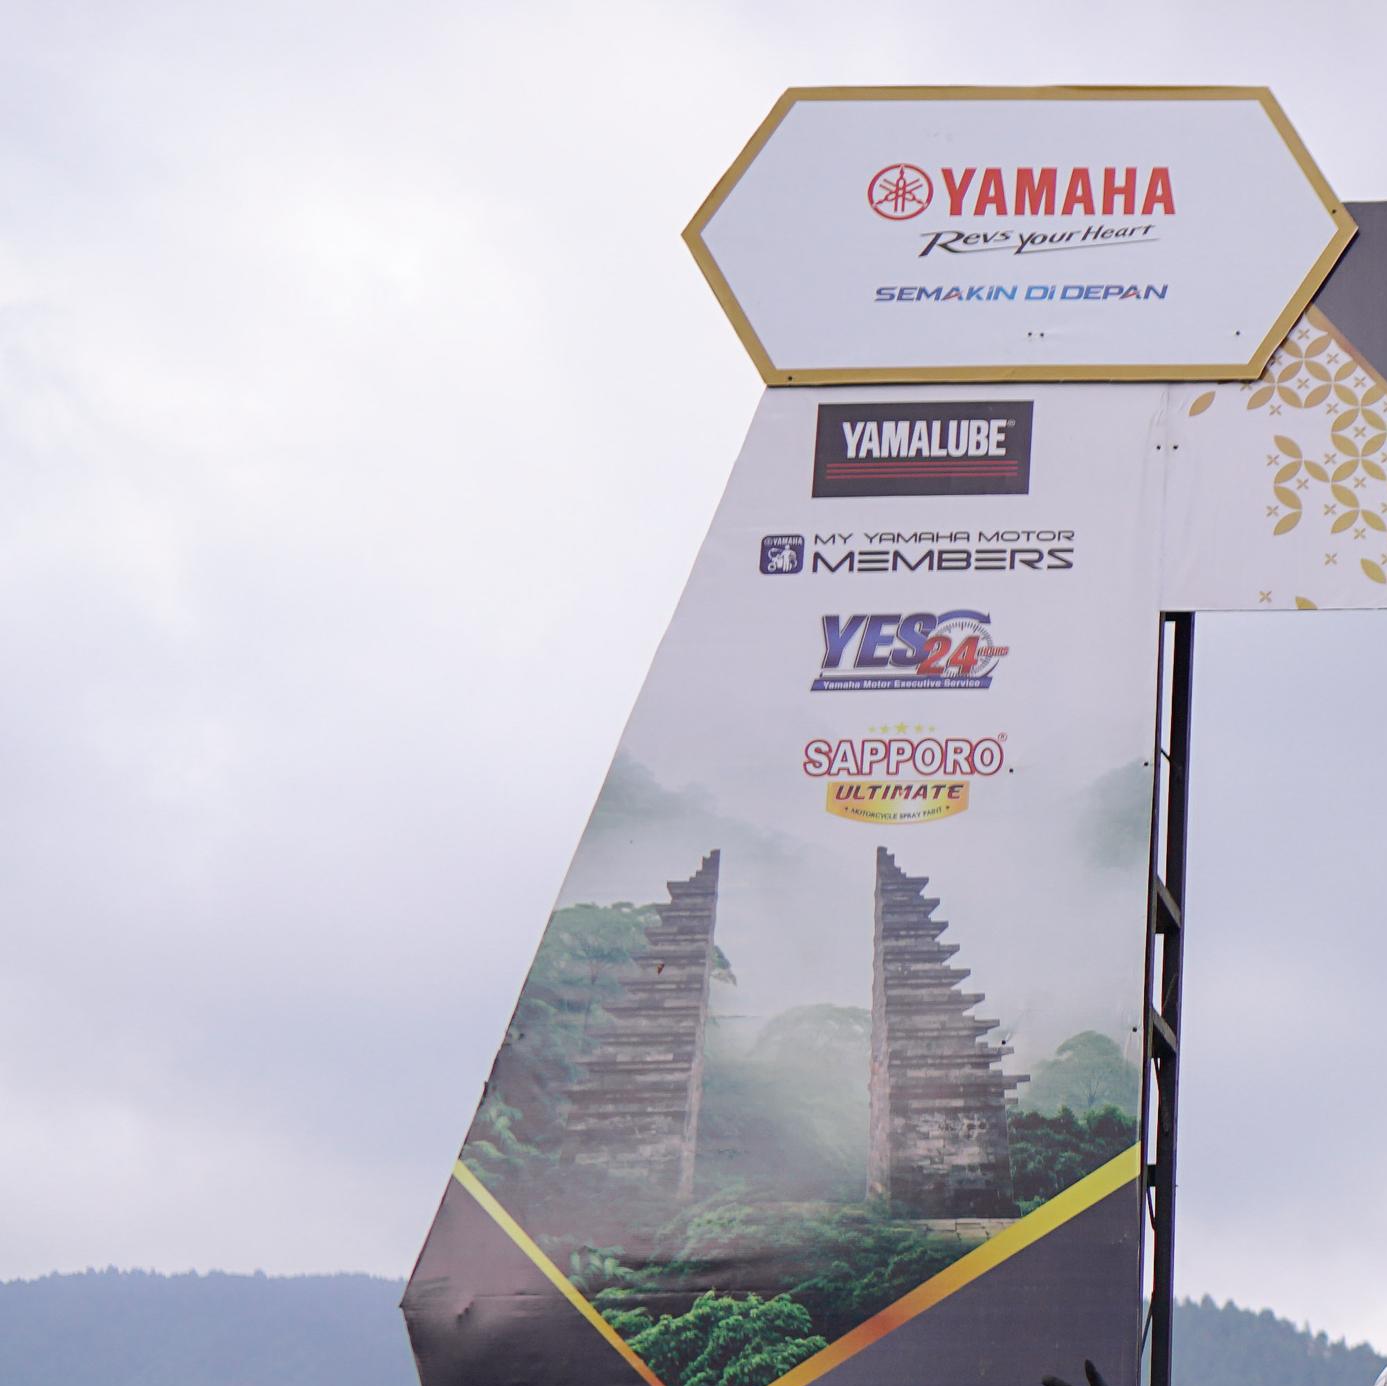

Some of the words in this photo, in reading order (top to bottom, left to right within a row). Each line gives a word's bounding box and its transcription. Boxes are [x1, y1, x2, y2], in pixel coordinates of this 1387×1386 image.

[941, 166, 1176, 216] YAMAHA
[918, 230, 1013, 257] Revs
[1013, 231, 1081, 255] your
[1080, 224, 1156, 241] Heart
[1060, 284, 1168, 300] DEPAN
[842, 419, 1007, 458] YAMALUBE
[815, 533, 853, 545] MY
[864, 531, 970, 543] YAMAHA
[979, 530, 1075, 542] MOTOR
[812, 548, 1074, 573] MEMBERS
[822, 613, 938, 669] YES
[916, 635, 980, 677] 24
[823, 680, 860, 689] Yamaha
[863, 680, 891, 689] Motor
[894, 679, 941, 688] Executive
[944, 679, 981, 688] Service
[803, 738, 1004, 776] SAPPORO
[835, 784, 964, 800] ULTIMATE
